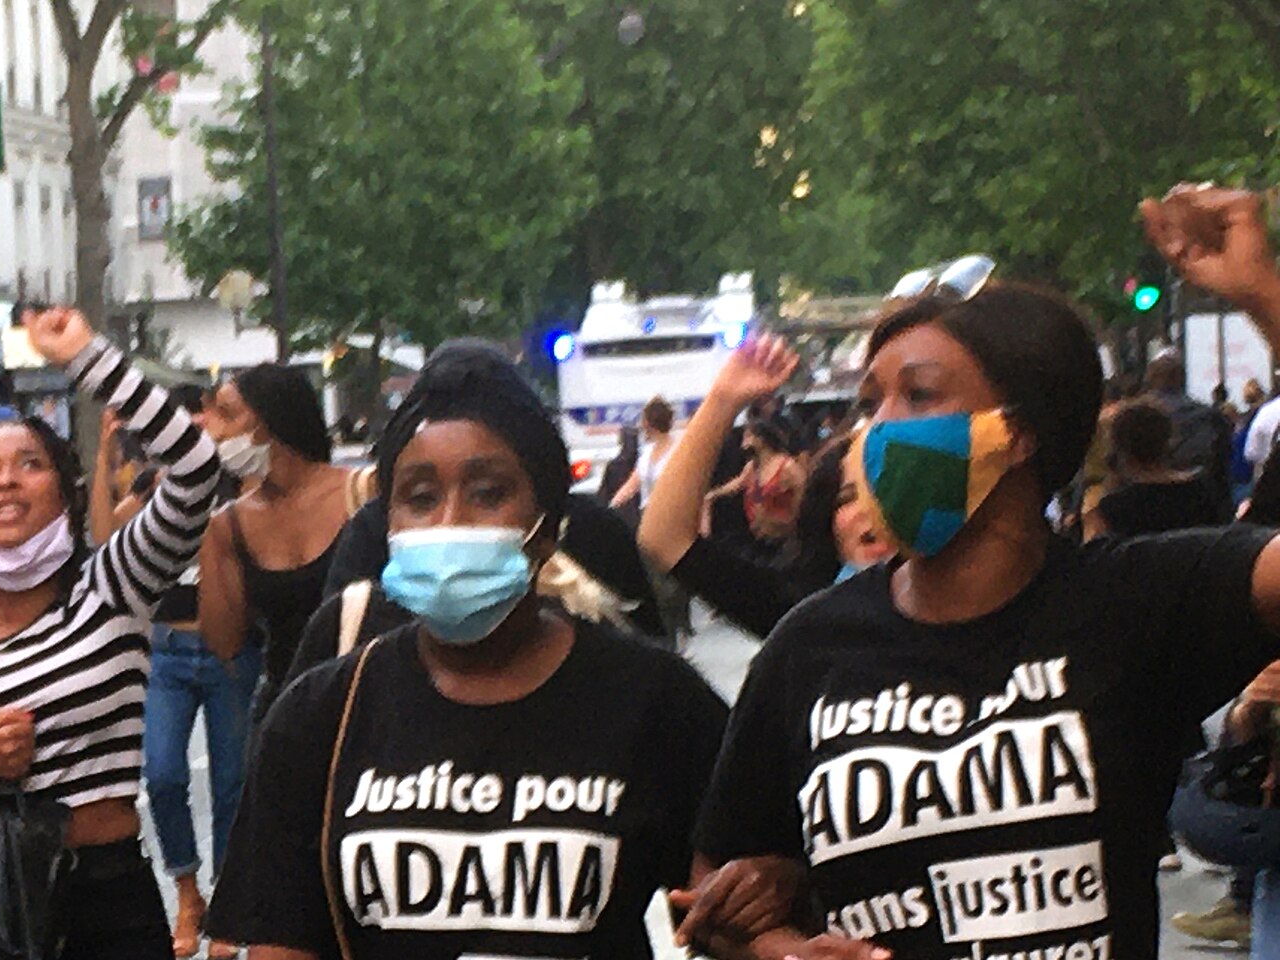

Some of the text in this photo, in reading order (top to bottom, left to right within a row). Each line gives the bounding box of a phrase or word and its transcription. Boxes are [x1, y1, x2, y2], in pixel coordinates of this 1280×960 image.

[345, 760, 626, 821] Justice pour
[805, 724, 1090, 854] ADAMA
[352, 840, 604, 920] ADAMA
[933, 856, 1101, 936] justice
